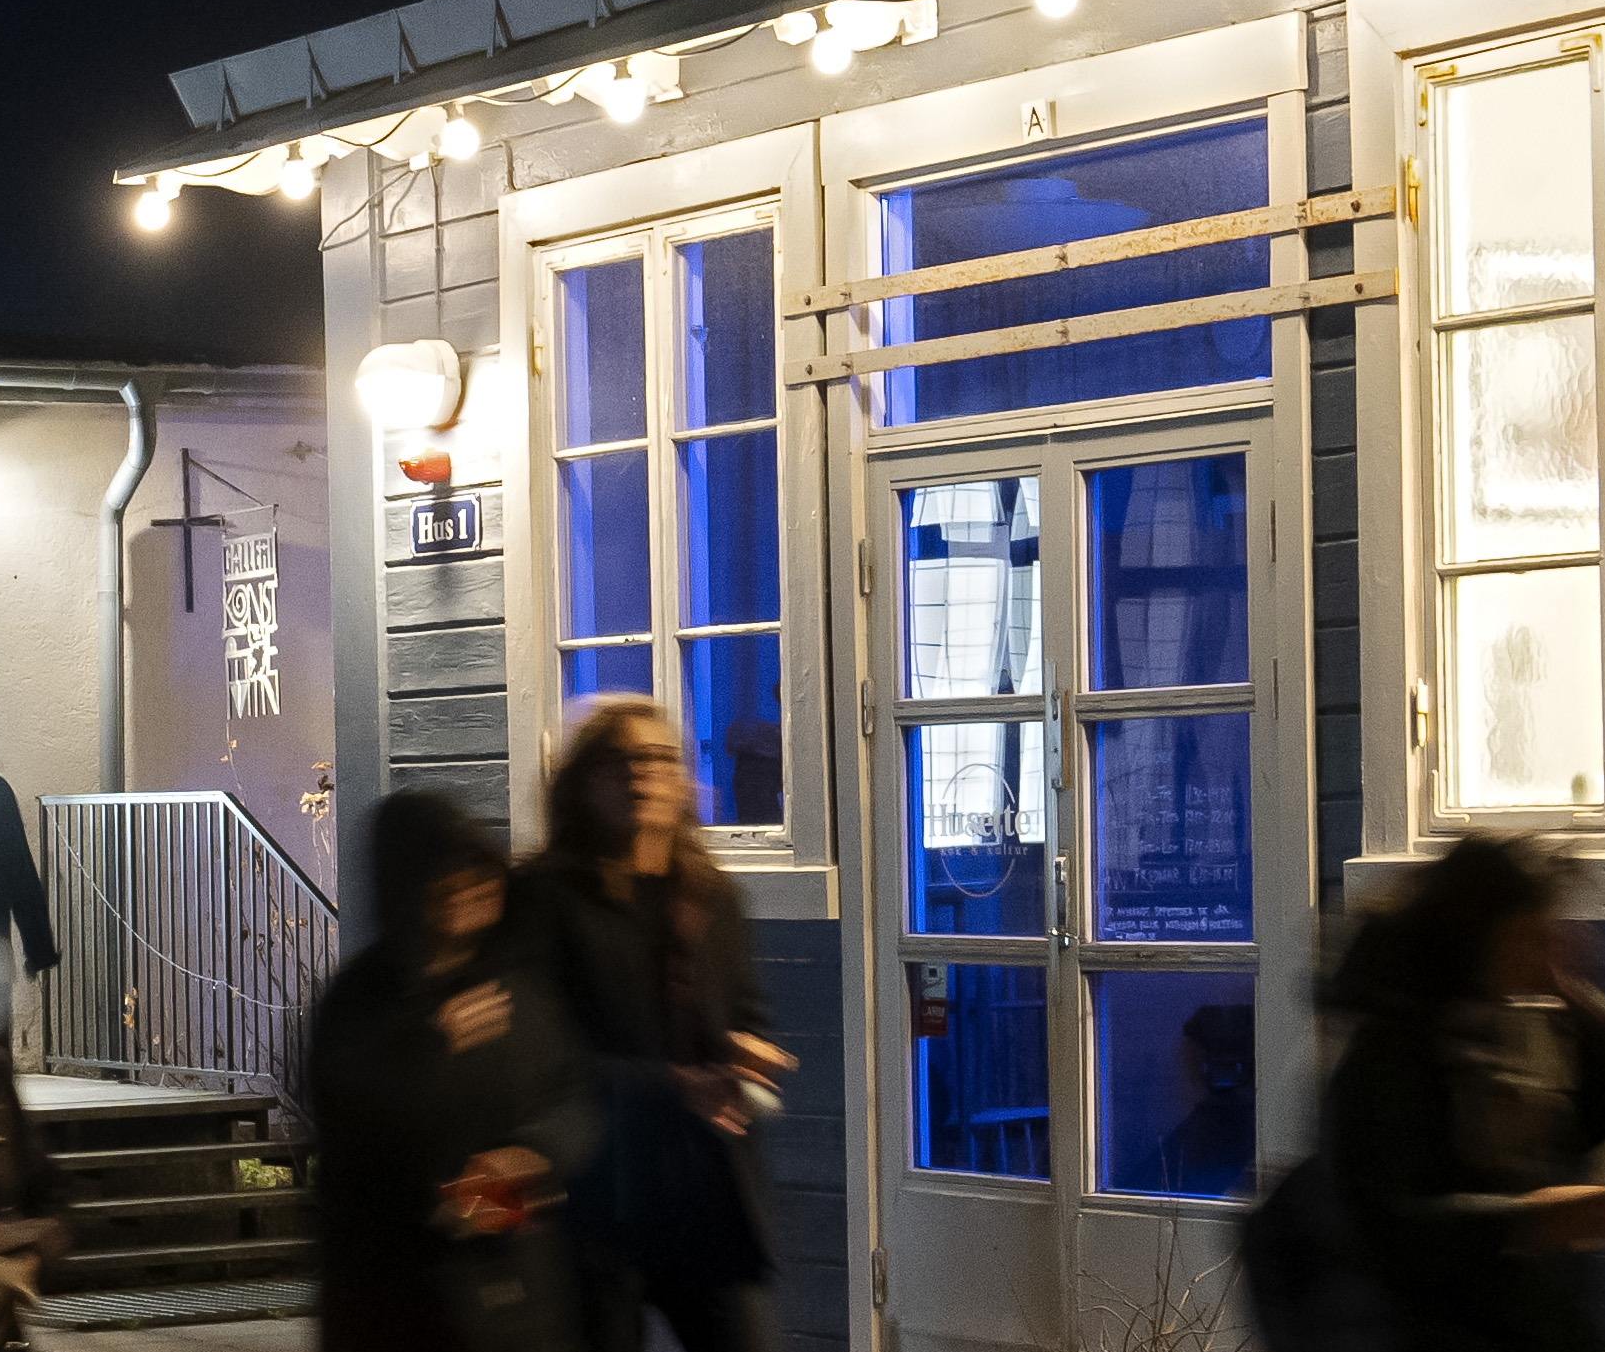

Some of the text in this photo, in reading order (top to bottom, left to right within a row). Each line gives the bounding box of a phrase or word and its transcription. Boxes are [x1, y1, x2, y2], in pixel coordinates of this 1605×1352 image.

[1028, 107, 1044, 137] A
[417, 508, 468, 544] Hus 1
